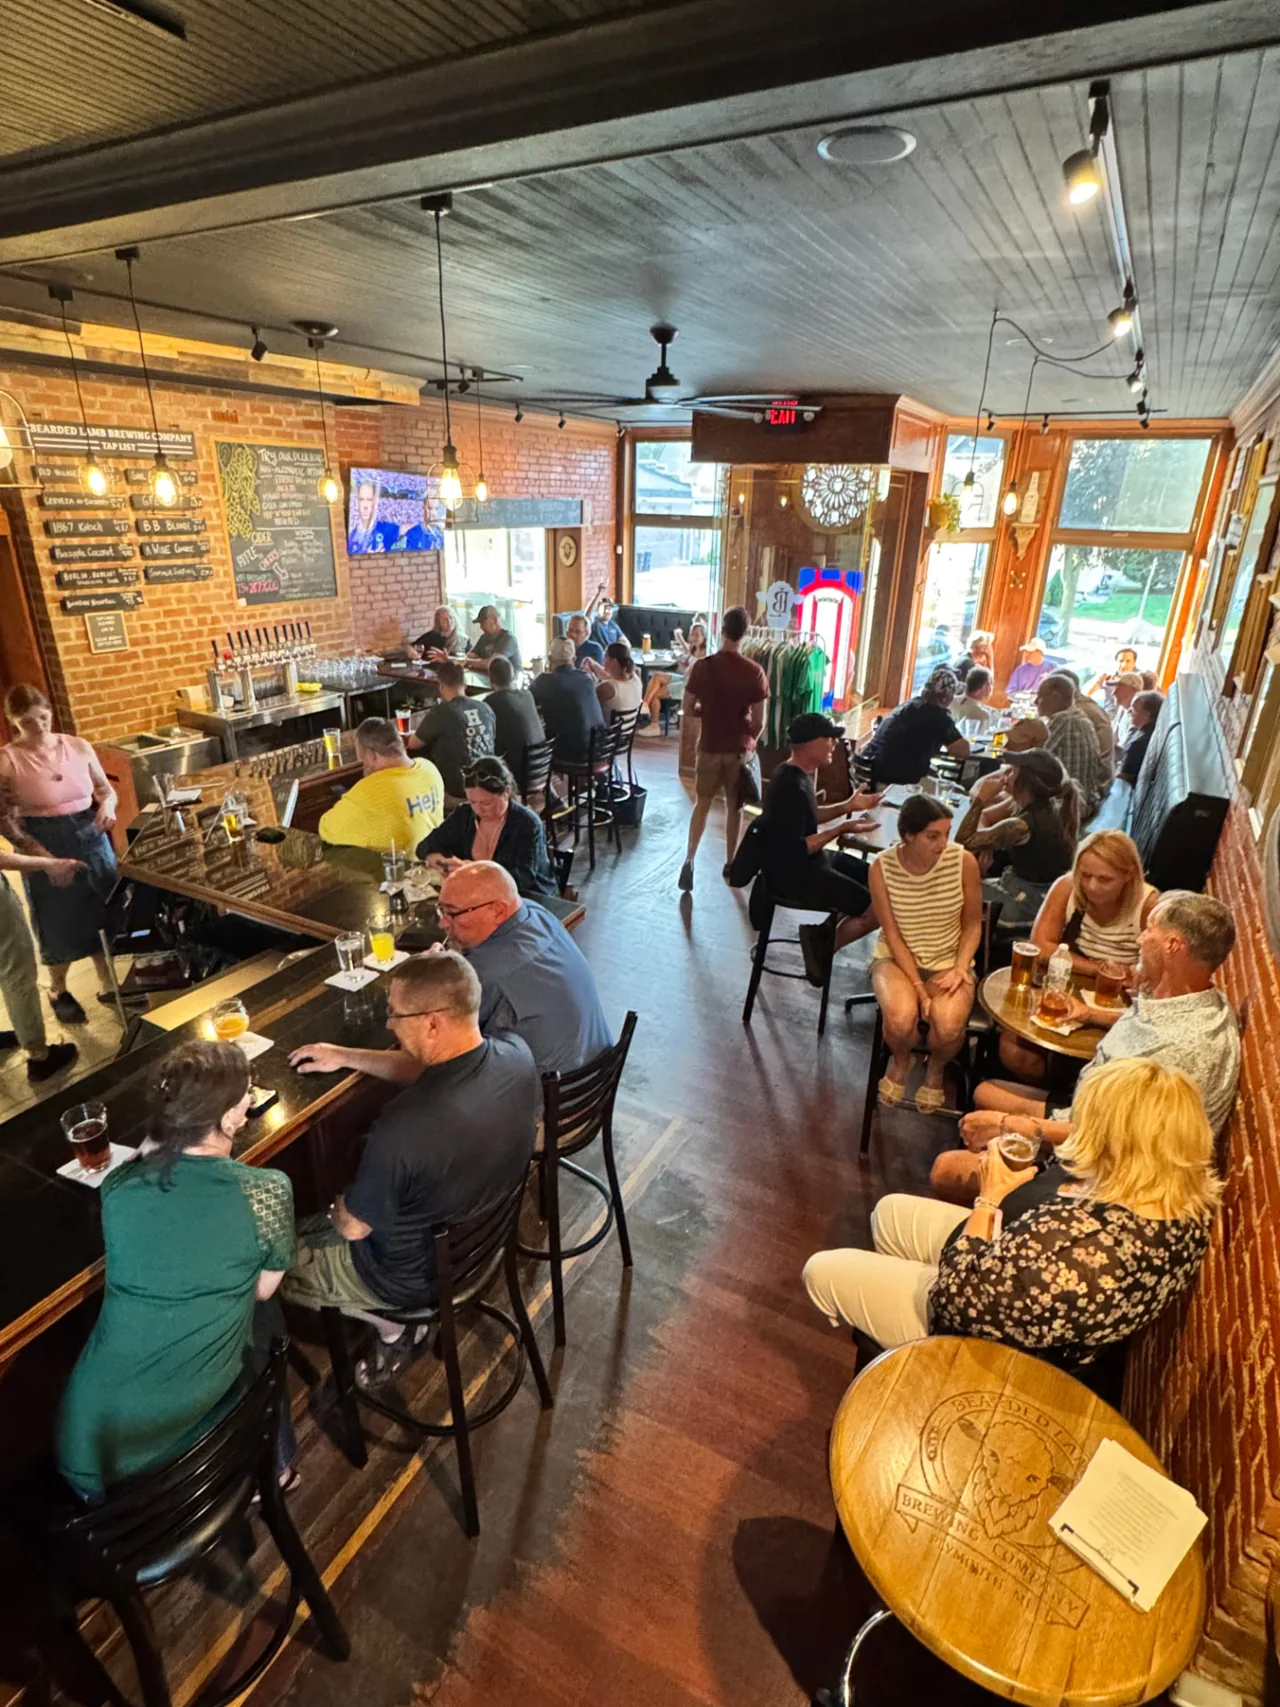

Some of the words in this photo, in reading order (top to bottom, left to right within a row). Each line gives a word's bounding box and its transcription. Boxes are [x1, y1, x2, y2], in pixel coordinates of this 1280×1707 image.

[770, 400, 798, 425] EXIT
[29, 424, 77, 436] BEARDED
[79, 427, 106, 438] LAMB
[107, 429, 151, 441] BREWING
[152, 431, 193, 443] COMPANY
[101, 441, 118, 450] TAP
[119, 443, 137, 452] LIST
[52, 522, 74, 534] 1867
[951, 1395, 1050, 1428] BEADED
